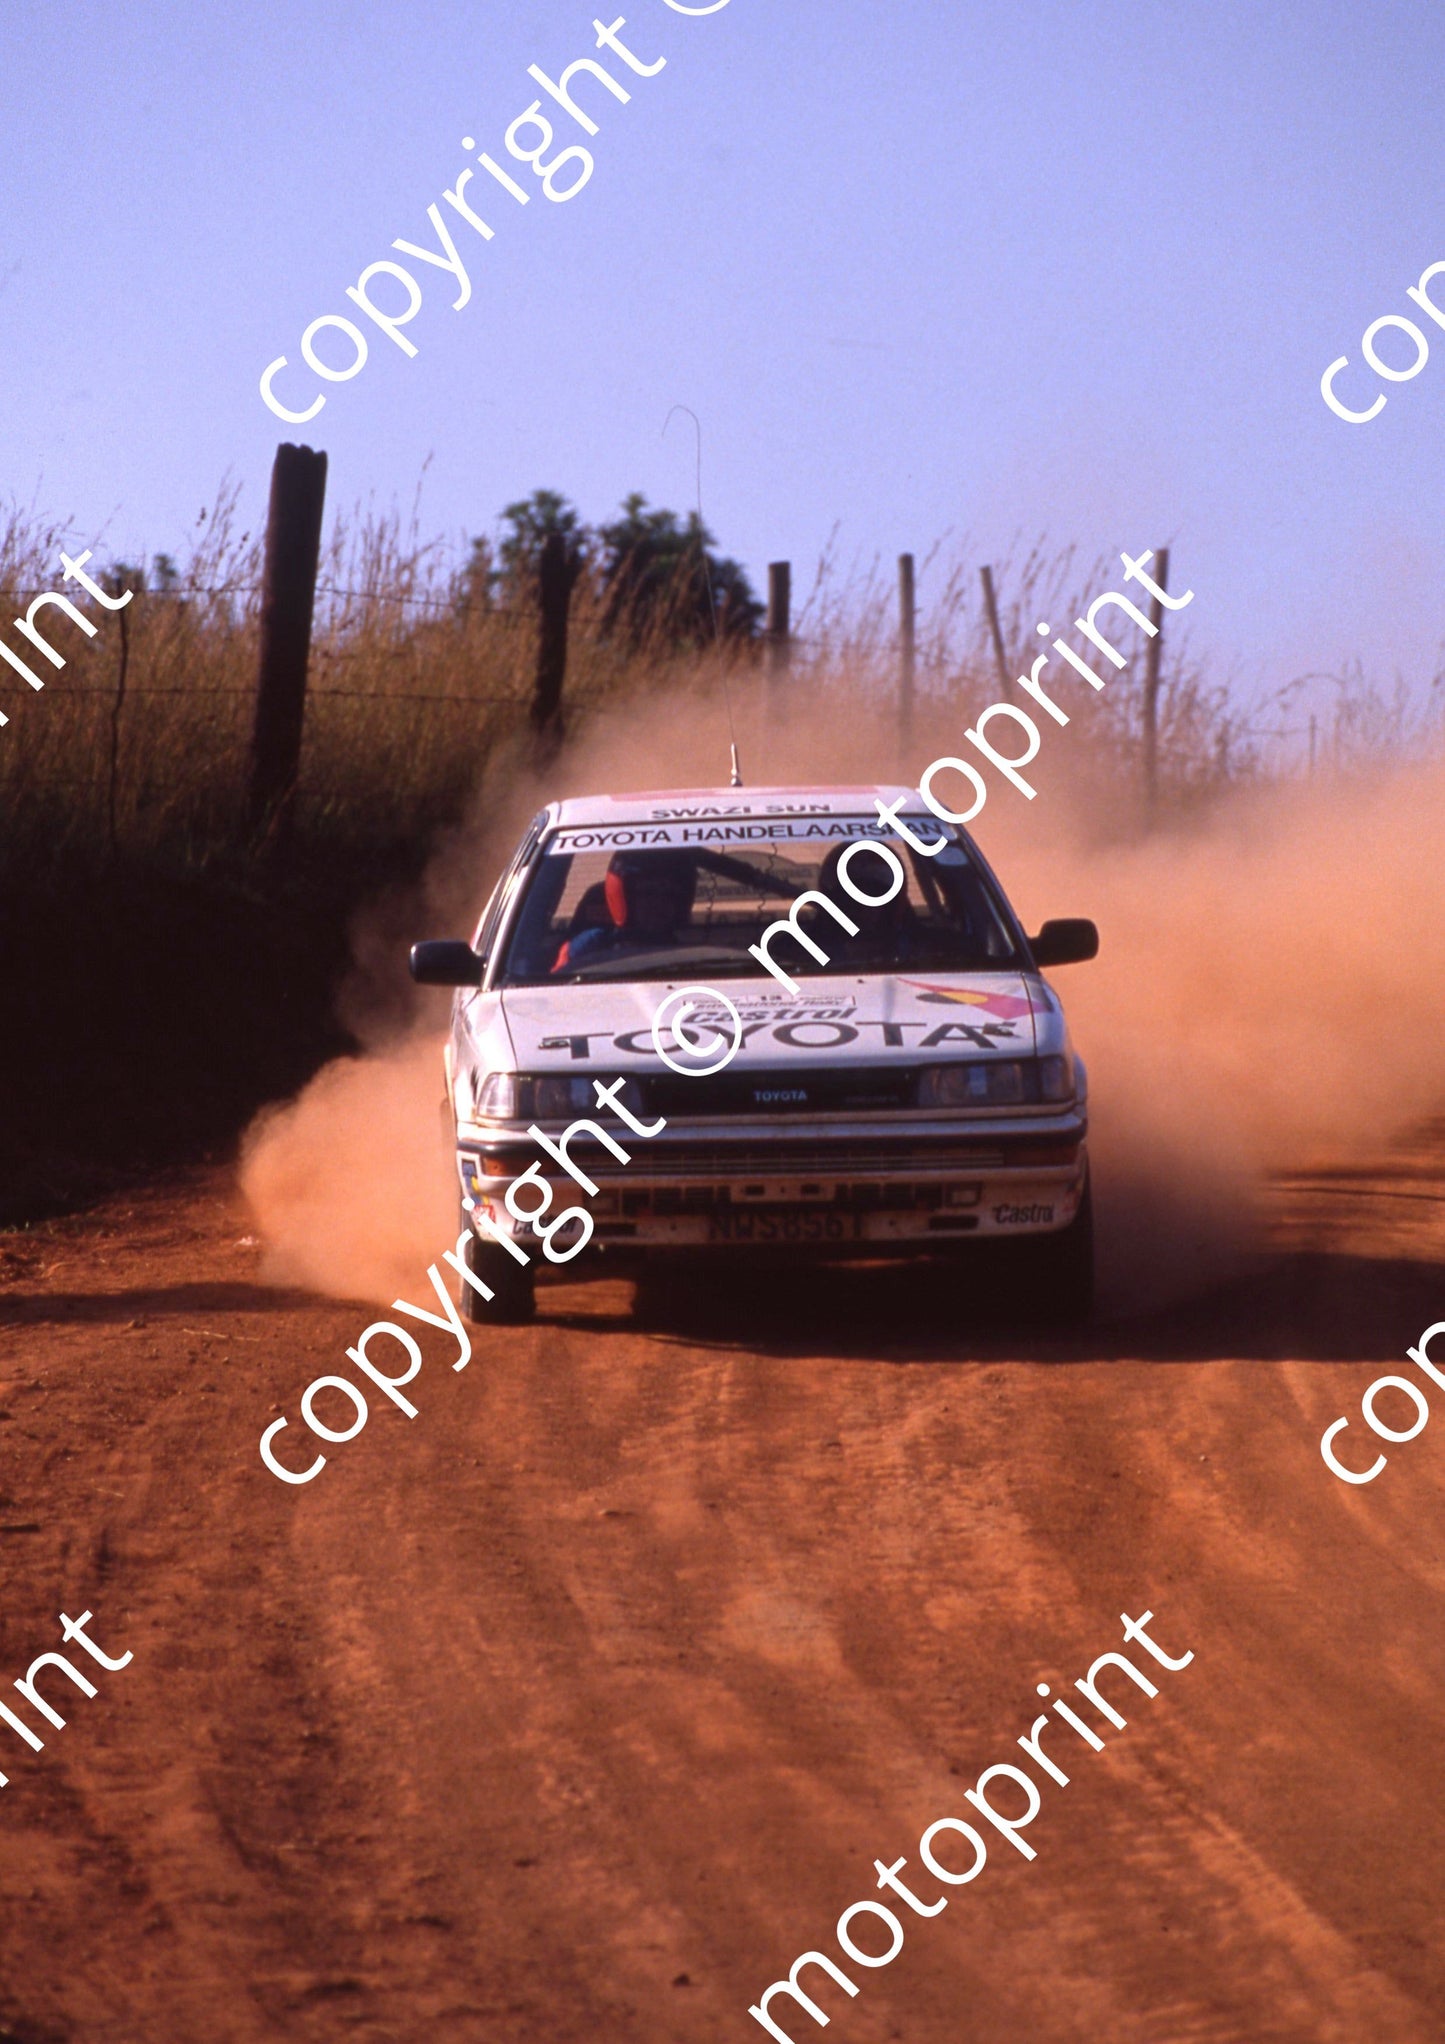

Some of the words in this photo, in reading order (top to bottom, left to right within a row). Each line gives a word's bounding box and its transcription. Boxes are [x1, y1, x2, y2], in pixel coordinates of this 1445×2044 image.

[652, 806, 752, 819] SWAZI
[766, 804, 831, 814] SUN
[556, 829, 673, 849] TOYOTA
[543, 1020, 998, 1060] TOYOTA
[753, 1089, 808, 1103] TOYOTA
